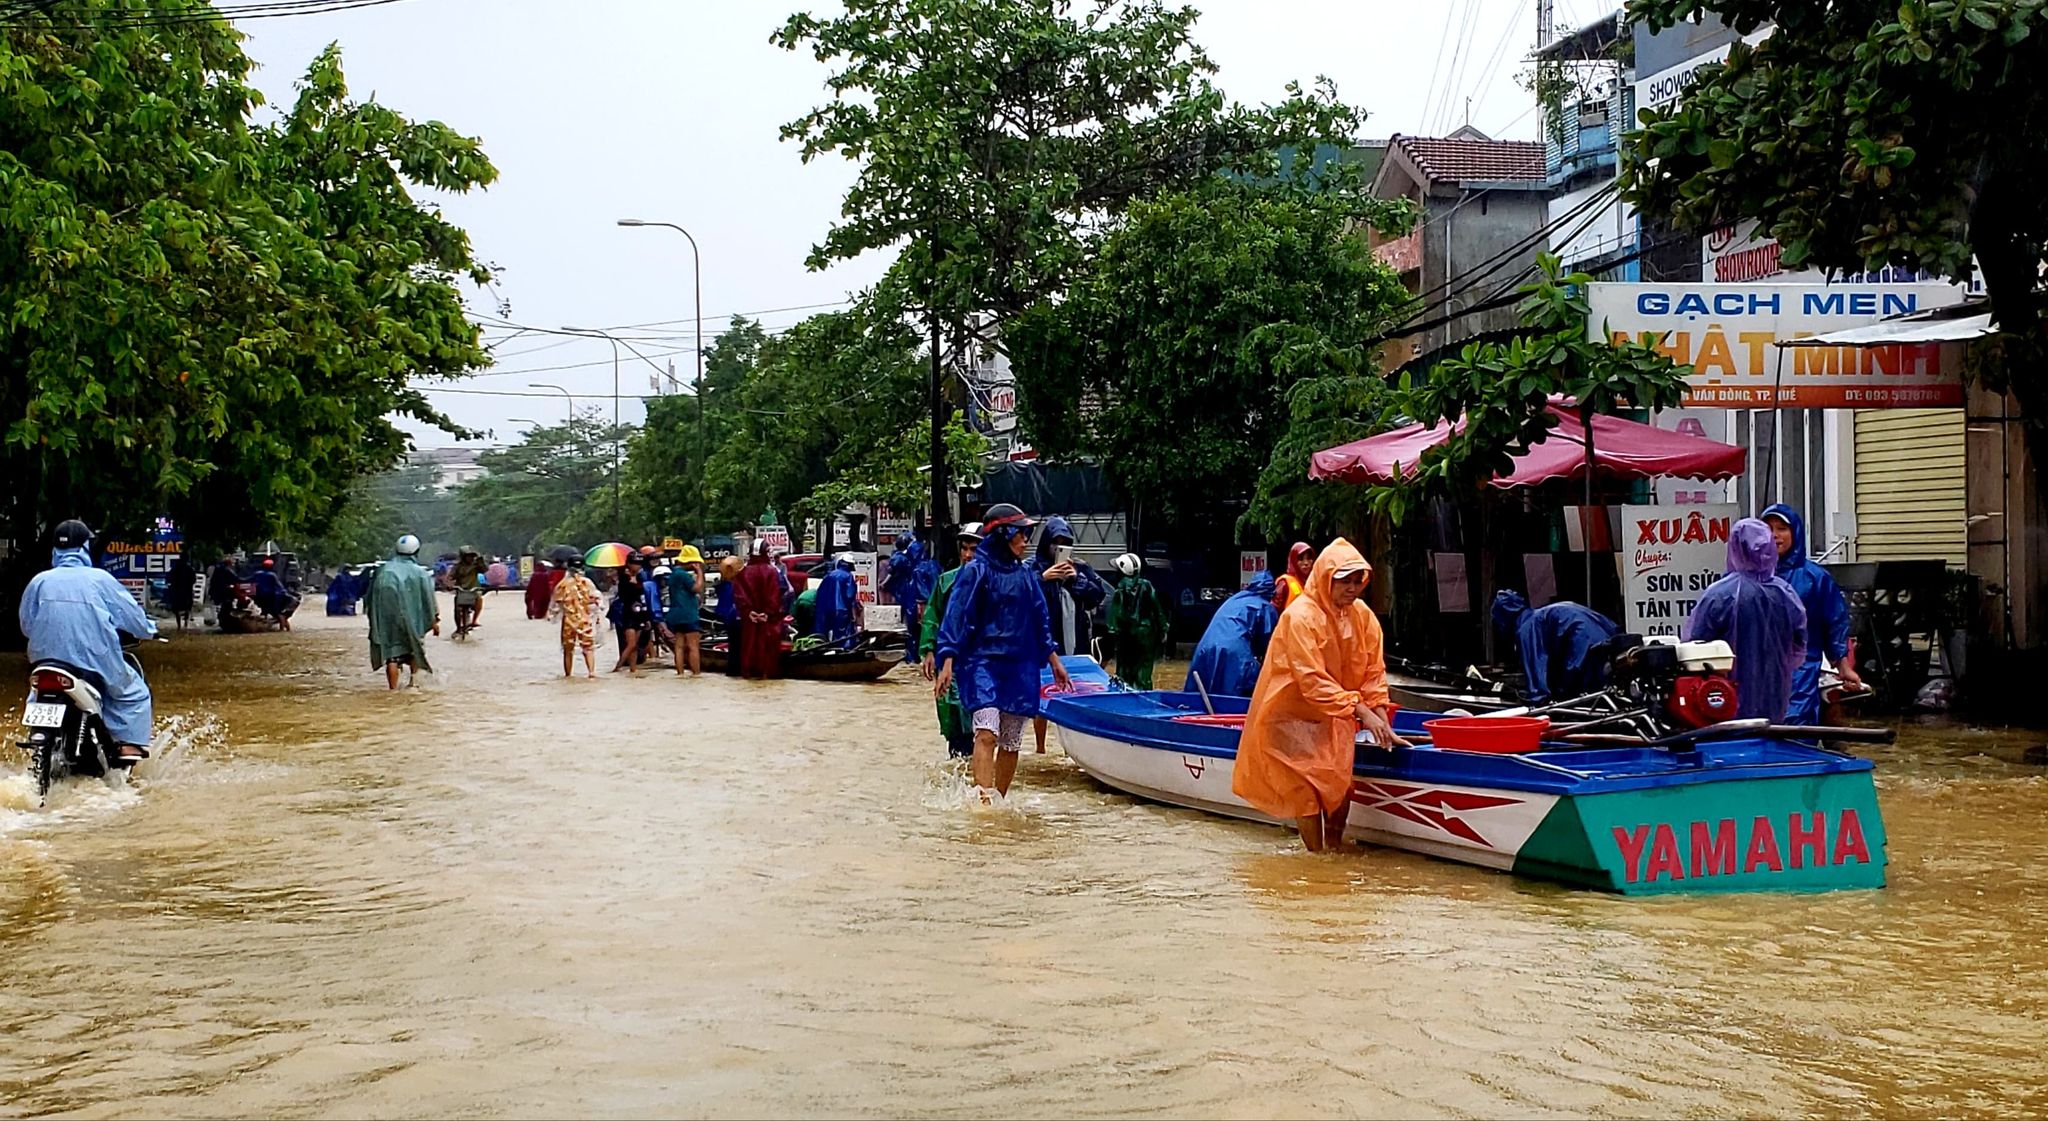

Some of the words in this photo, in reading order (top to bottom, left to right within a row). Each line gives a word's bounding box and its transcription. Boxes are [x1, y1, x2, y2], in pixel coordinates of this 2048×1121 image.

[1714, 242, 1781, 283] SHOWROOM
[1637, 292, 1781, 321] GẠCH
[1802, 292, 1918, 316] MEN
[1636, 511, 1731, 545] XUÂN
[1646, 572, 1684, 593] SƠN
[1635, 598, 1672, 618] TÂN
[1612, 808, 1871, 884] YAMAHA
